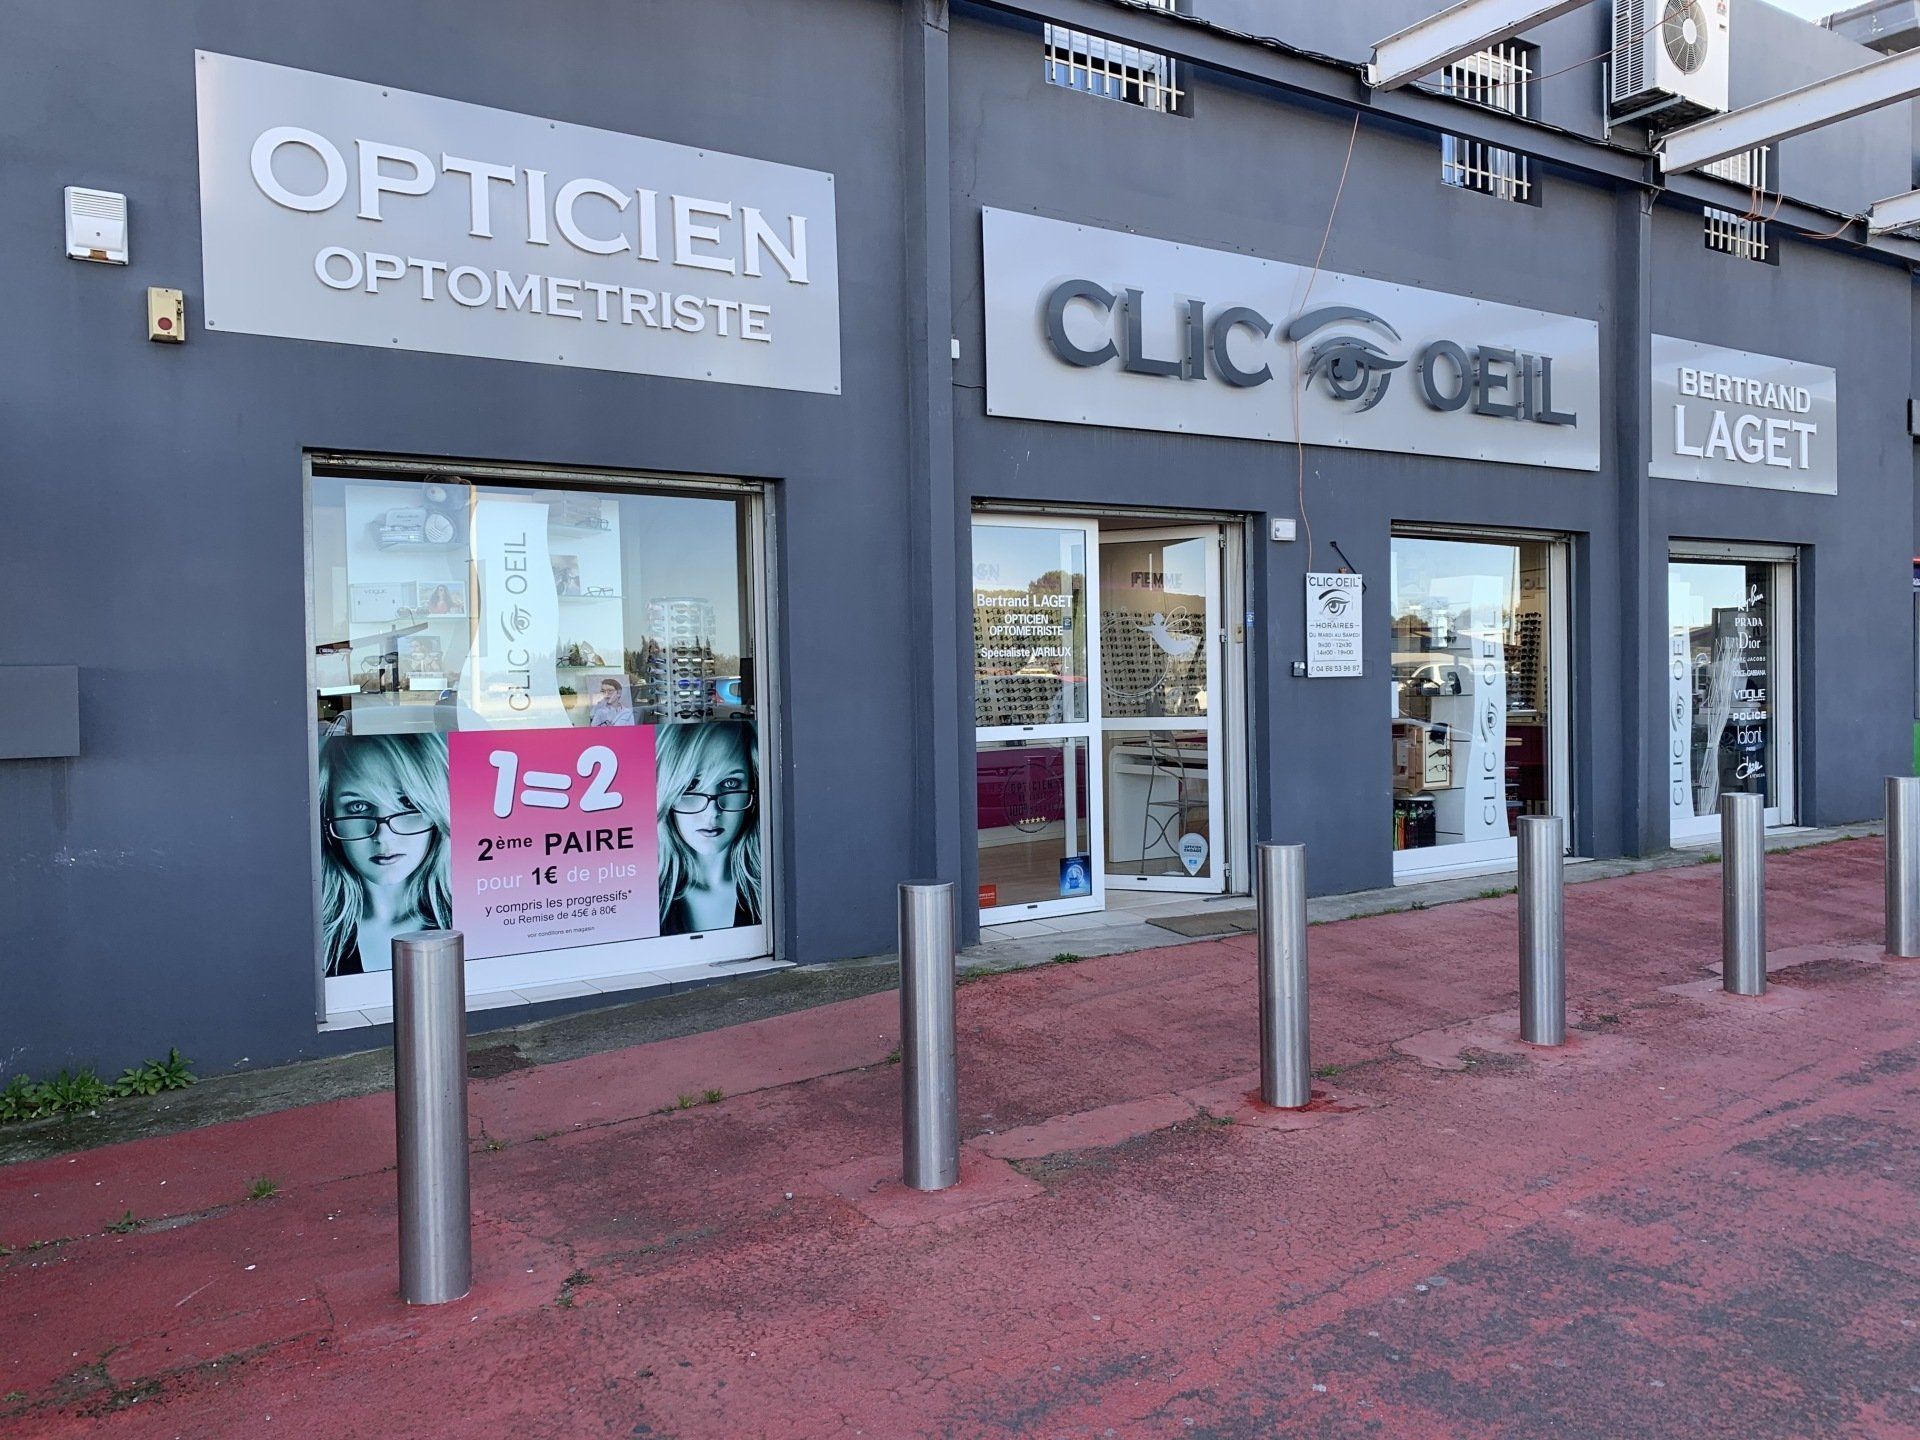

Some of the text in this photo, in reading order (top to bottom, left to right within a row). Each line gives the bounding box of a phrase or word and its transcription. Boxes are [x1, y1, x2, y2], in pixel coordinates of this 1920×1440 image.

[251, 126, 810, 284] OPTICIEN
[314, 246, 772, 343] OPTOMETRISTE
[1046, 277, 1577, 428] CLIC OEIL
[1678, 367, 1811, 415] BERTRAND
[1674, 403, 1816, 471] LAGET
[1308, 577, 1359, 588] CLIC OEIL
[976, 593, 1073, 608] Bertrand LAGET
[1736, 584, 1764, 612] Ry-Ban
[503, 532, 531, 711] CLIC OEIL
[989, 625, 1064, 636] OPTOMETRISTE
[1004, 613, 1049, 625] OPTICIEN
[1734, 617, 1763, 627] PRADA
[981, 646, 1072, 660] Spécialiste VARILUX
[1739, 631, 1761, 649] Dior
[1733, 688, 1766, 700] VOGUE
[1483, 611, 1497, 826] CLIC OEIL
[1733, 710, 1767, 721] POLICE
[488, 745, 624, 818] 1=2
[1673, 739, 1684, 806] CLIC
[477, 827, 634, 862] 2ème PAIRE
[477, 862, 637, 895] pour 1€ de plus
[485, 906, 493, 917] y
[495, 899, 543, 915] compris
[546, 897, 563, 909] les
[503, 905, 617, 926] ou Remise de 45€ à 80€
